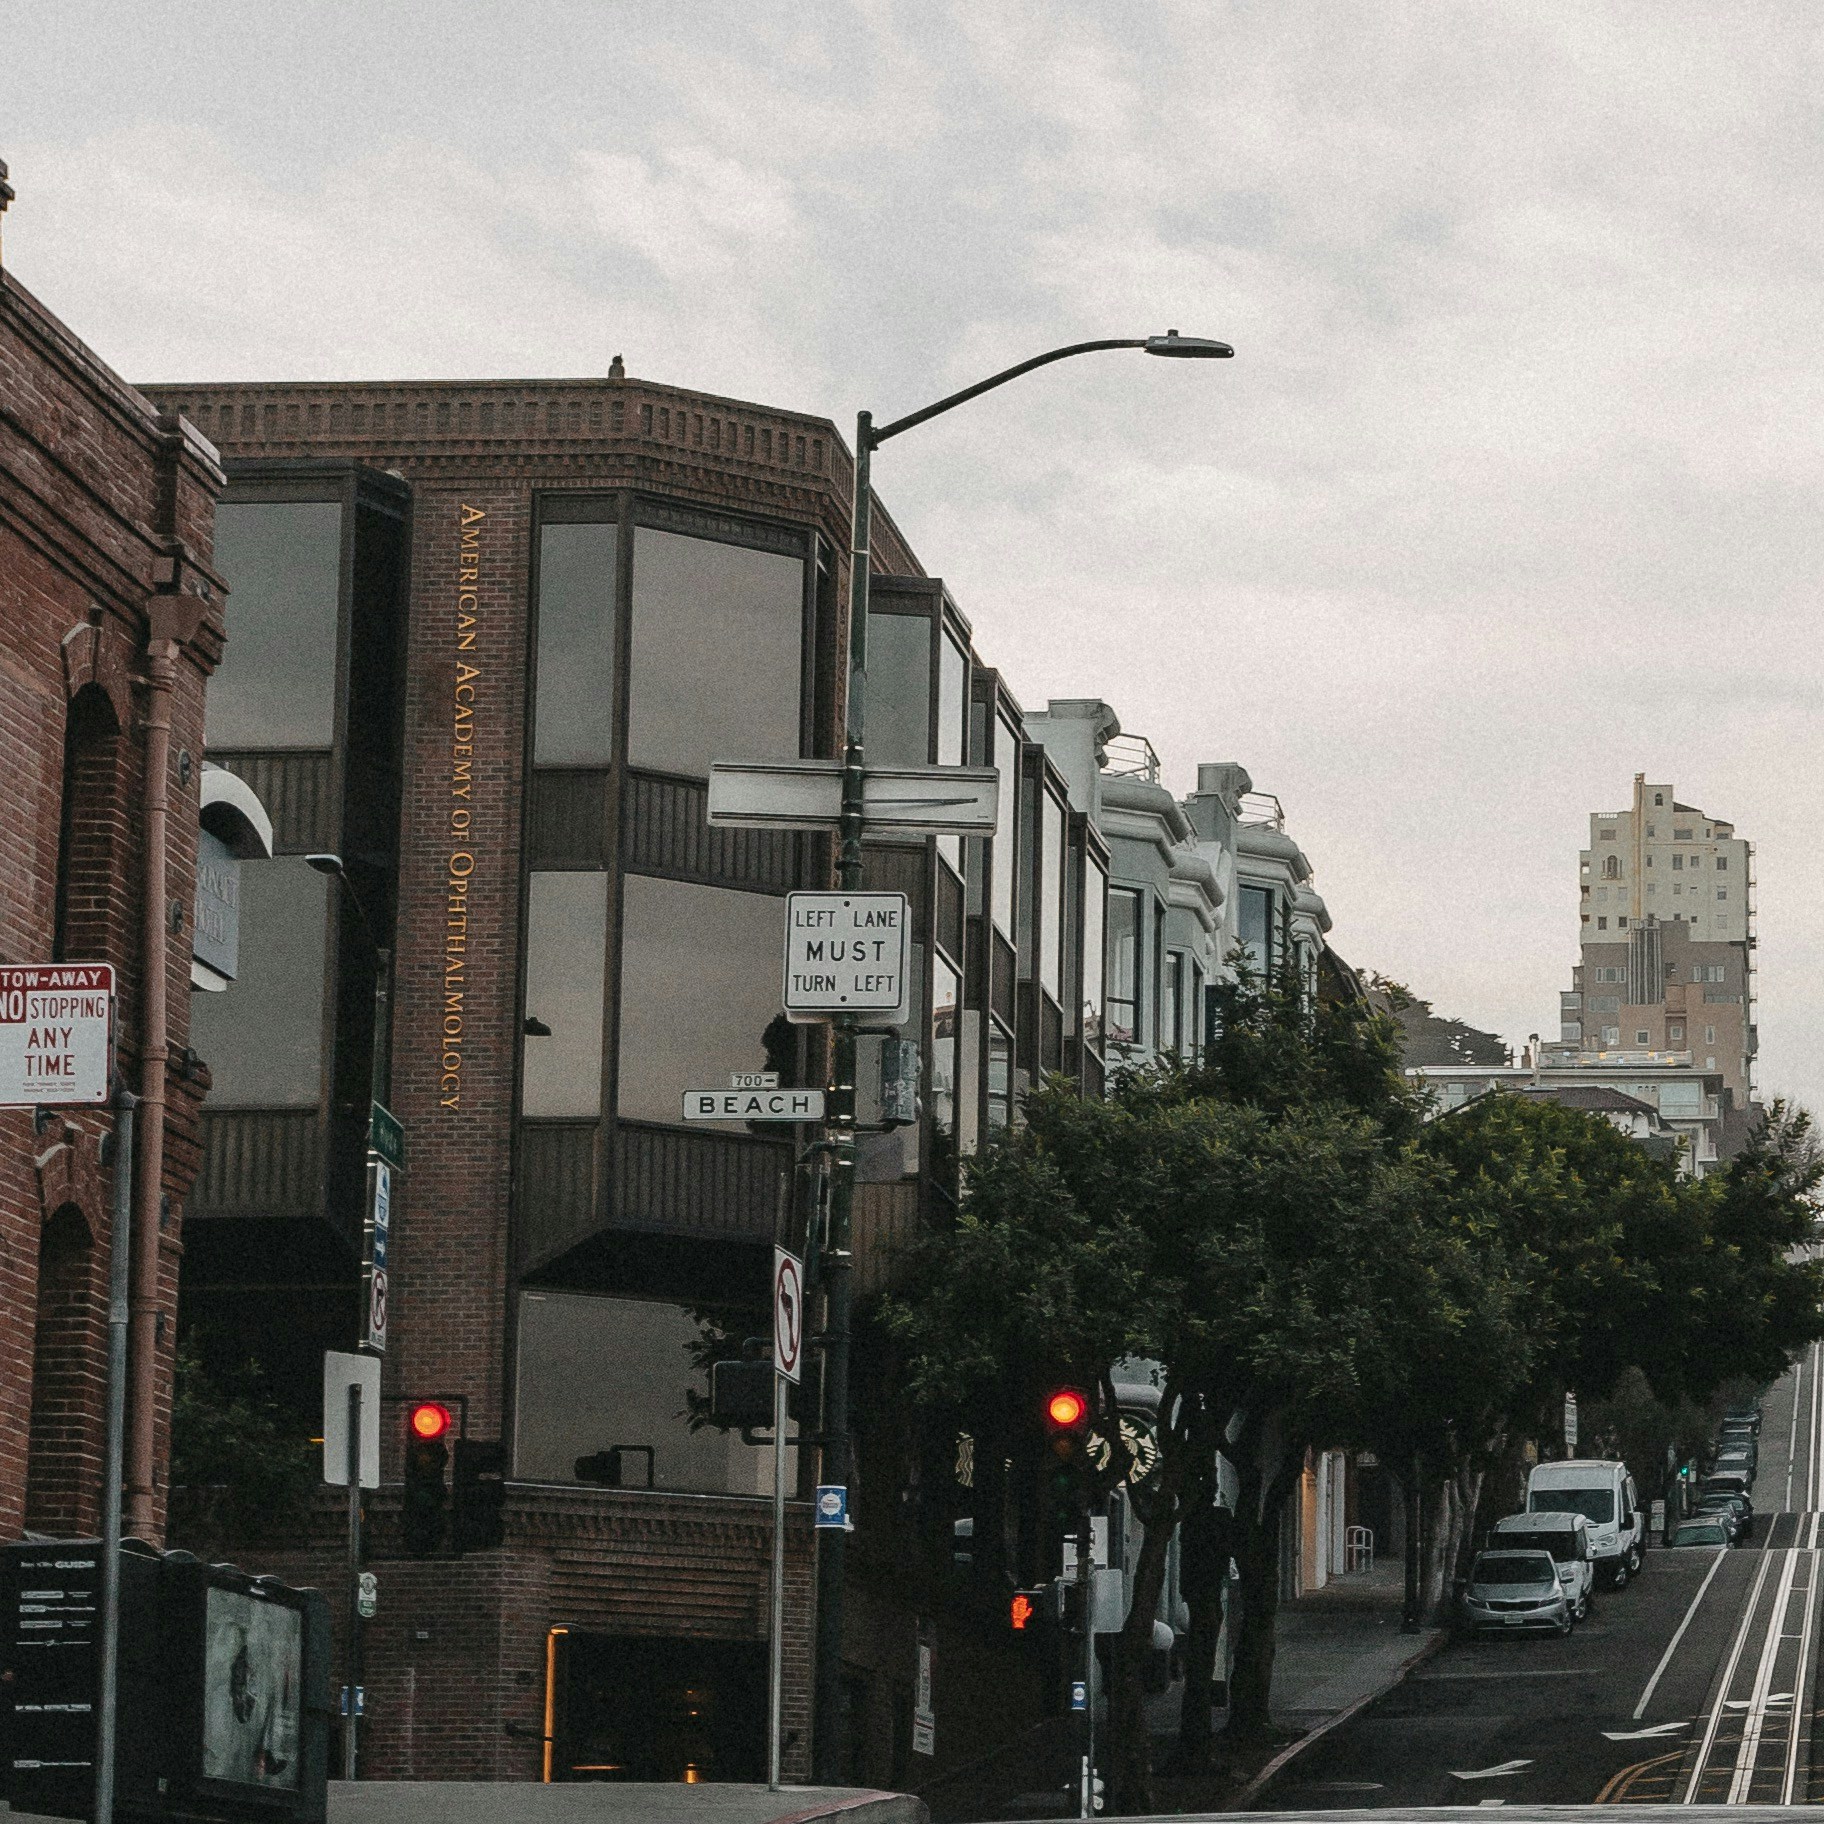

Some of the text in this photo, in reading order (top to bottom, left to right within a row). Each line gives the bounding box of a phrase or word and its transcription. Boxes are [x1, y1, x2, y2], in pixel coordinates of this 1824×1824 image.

[457, 503, 487, 651] AMERICAN
[452, 661, 481, 801] ACADEMY
[795, 910, 898, 928] LEFT LANE
[806, 940, 886, 962] MUST
[1, 970, 101, 987] TOW-AWAY
[440, 852, 476, 1111] OPHTHALMOLOGY
[793, 974, 895, 992] TURN LEFT
[30, 997, 105, 1020] STOPPING
[28, 1027, 73, 1049] ANY
[24, 1054, 76, 1076] TIME
[700, 1095, 809, 1114] BEACH
